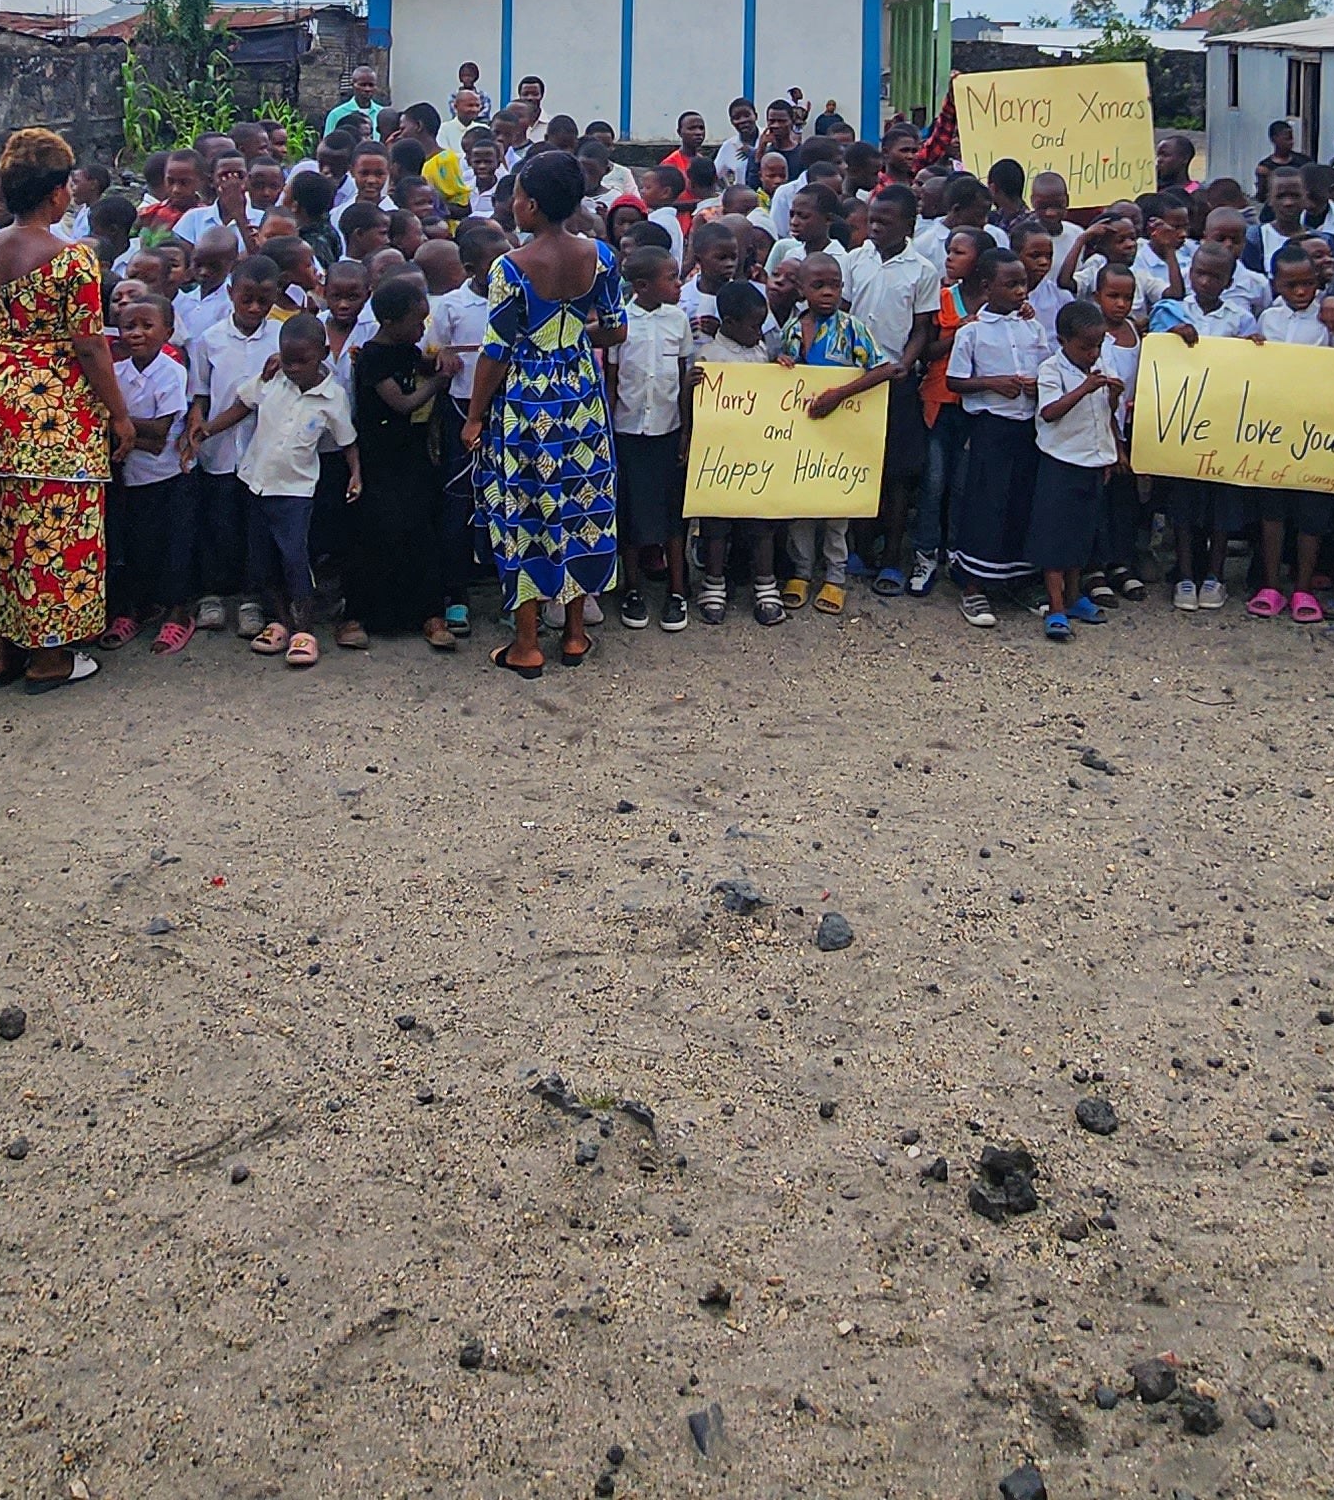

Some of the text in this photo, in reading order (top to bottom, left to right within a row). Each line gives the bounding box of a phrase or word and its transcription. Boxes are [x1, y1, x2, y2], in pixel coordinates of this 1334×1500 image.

[966, 81, 1145, 131] Marry Xmas
[1031, 128, 1067, 149] and
[1068, 147, 1154, 194] Holidays
[699, 371, 757, 415] Marry
[1153, 360, 1211, 446] We
[1235, 380, 1282, 444] love
[763, 420, 794, 440] and
[696, 446, 870, 495] Happy Holidays
[1195, 450, 1224, 476] The
[1233, 454, 1264, 481] Art
[1271, 465, 1291, 484] of
